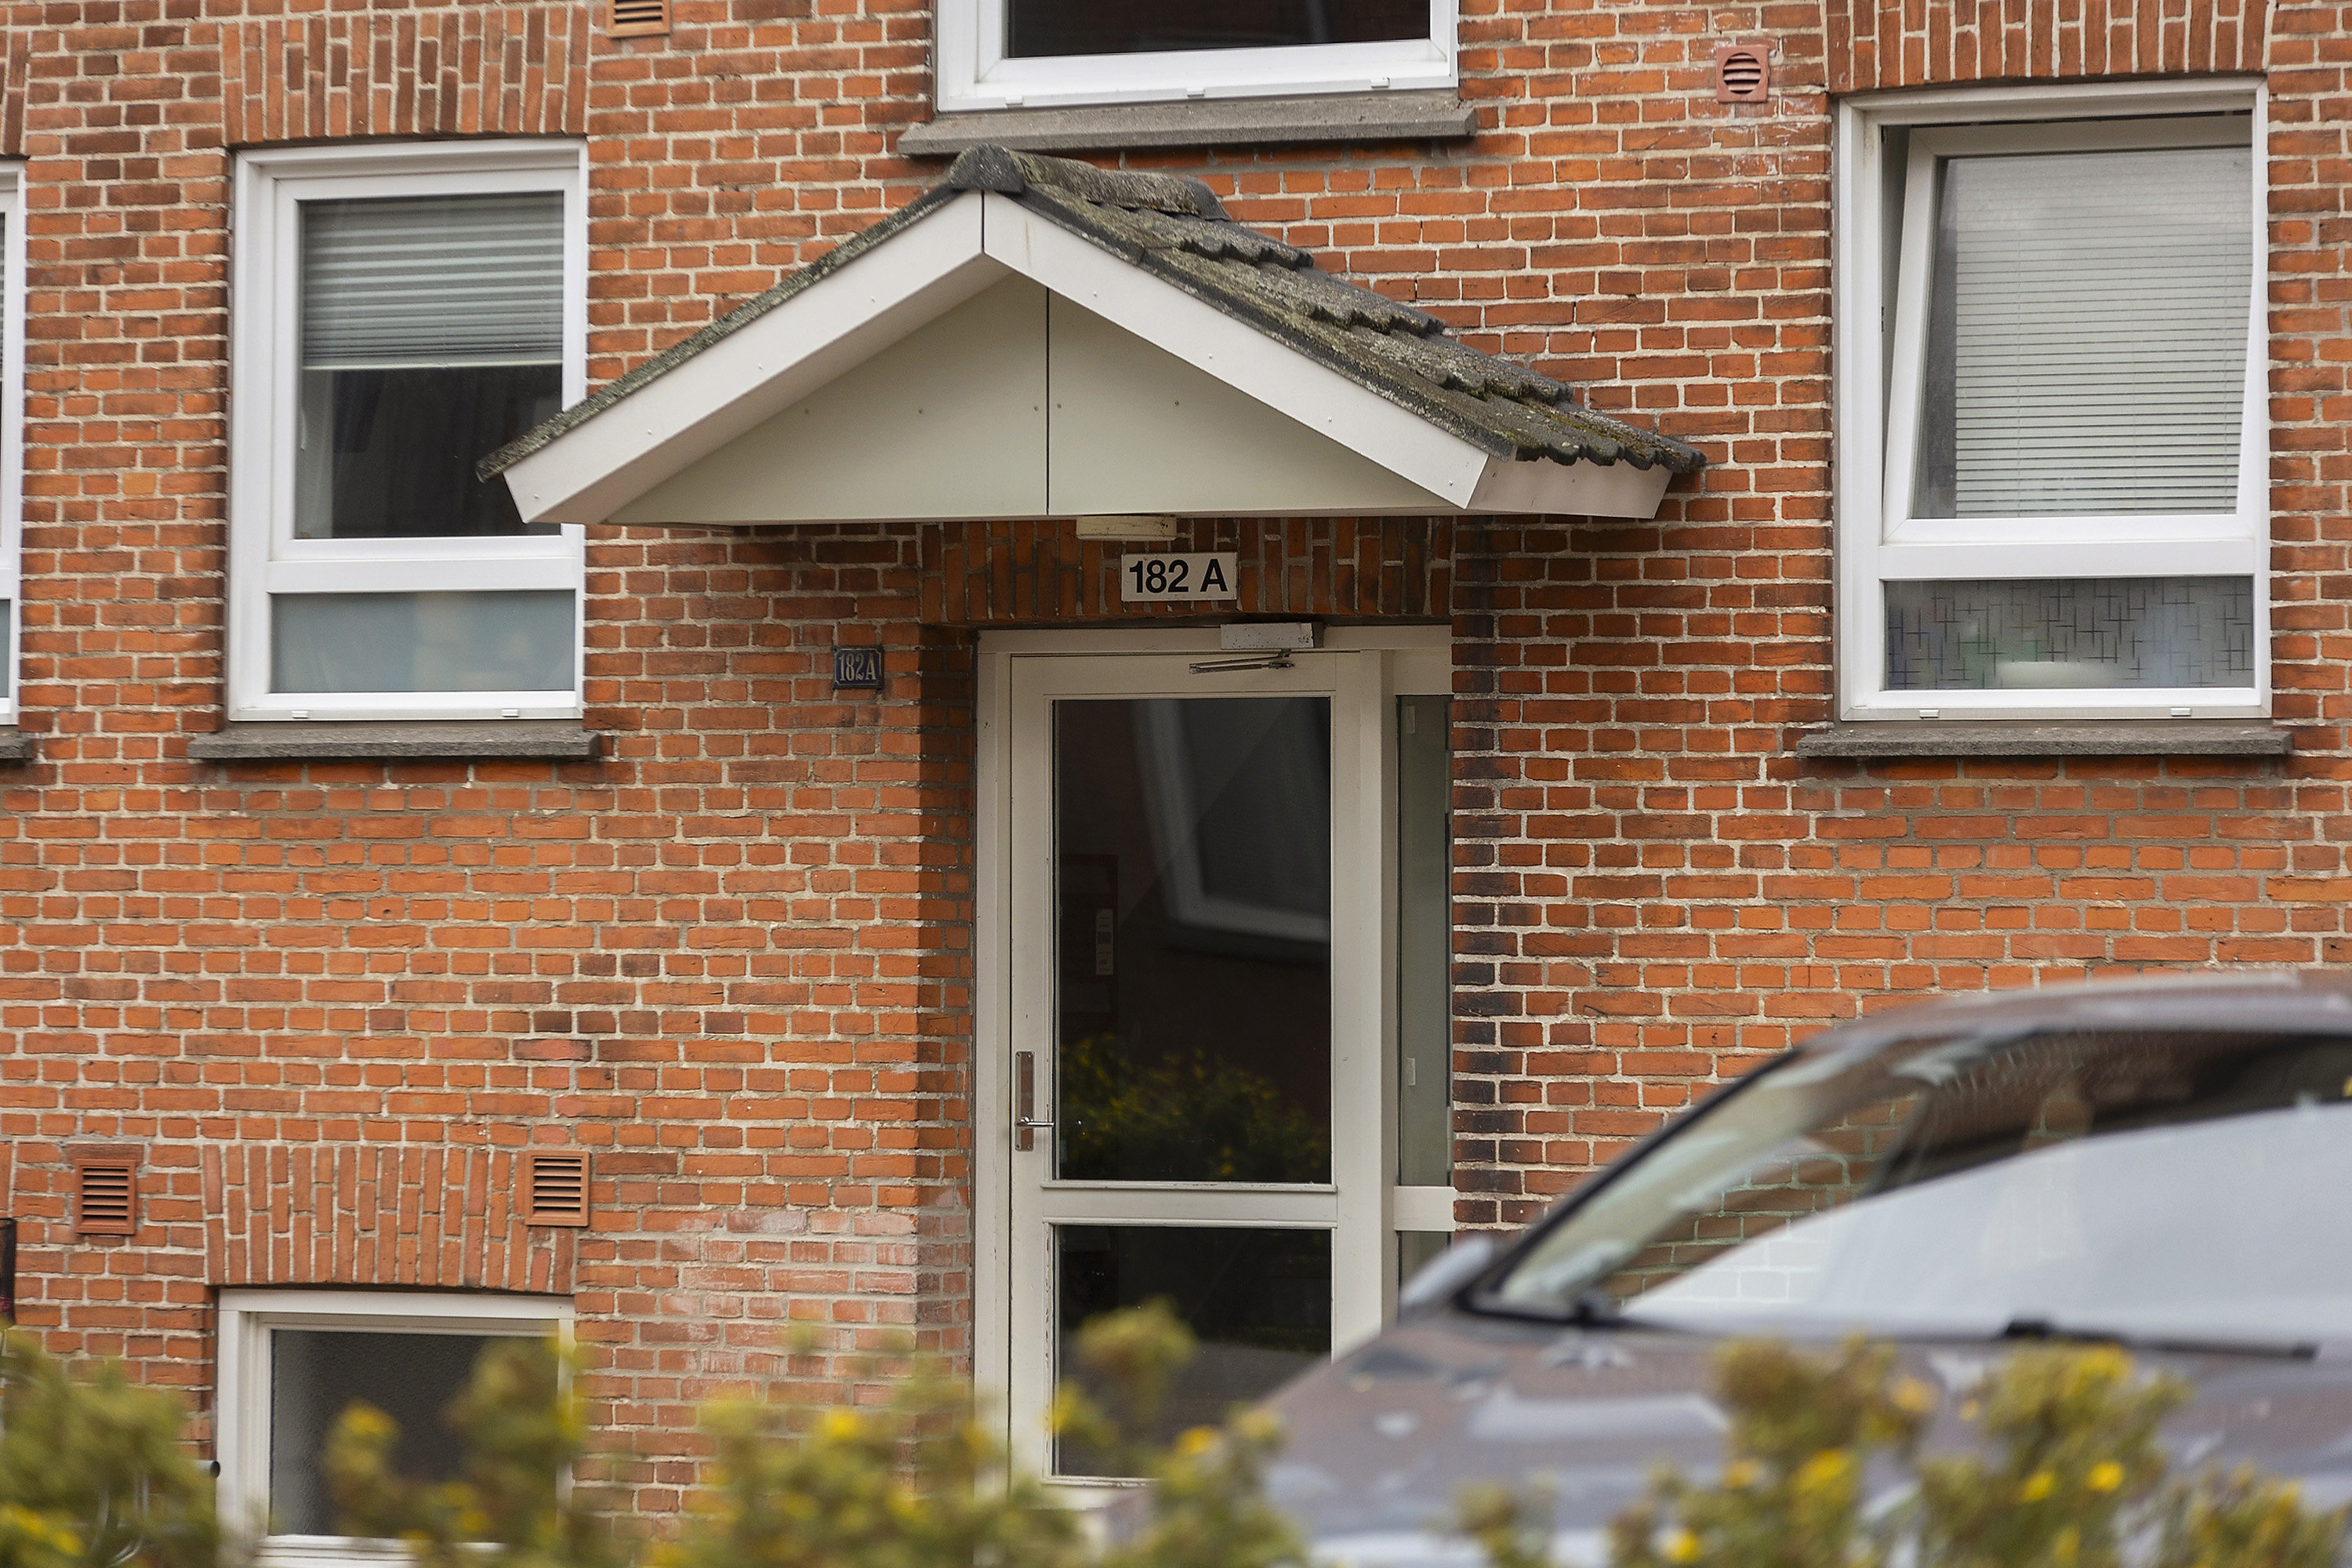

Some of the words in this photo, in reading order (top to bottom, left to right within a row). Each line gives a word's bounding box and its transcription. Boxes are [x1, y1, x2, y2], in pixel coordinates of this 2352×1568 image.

[1129, 559, 1189, 593] 182
[1200, 558, 1229, 592] A
[839, 652, 877, 681] 182A
